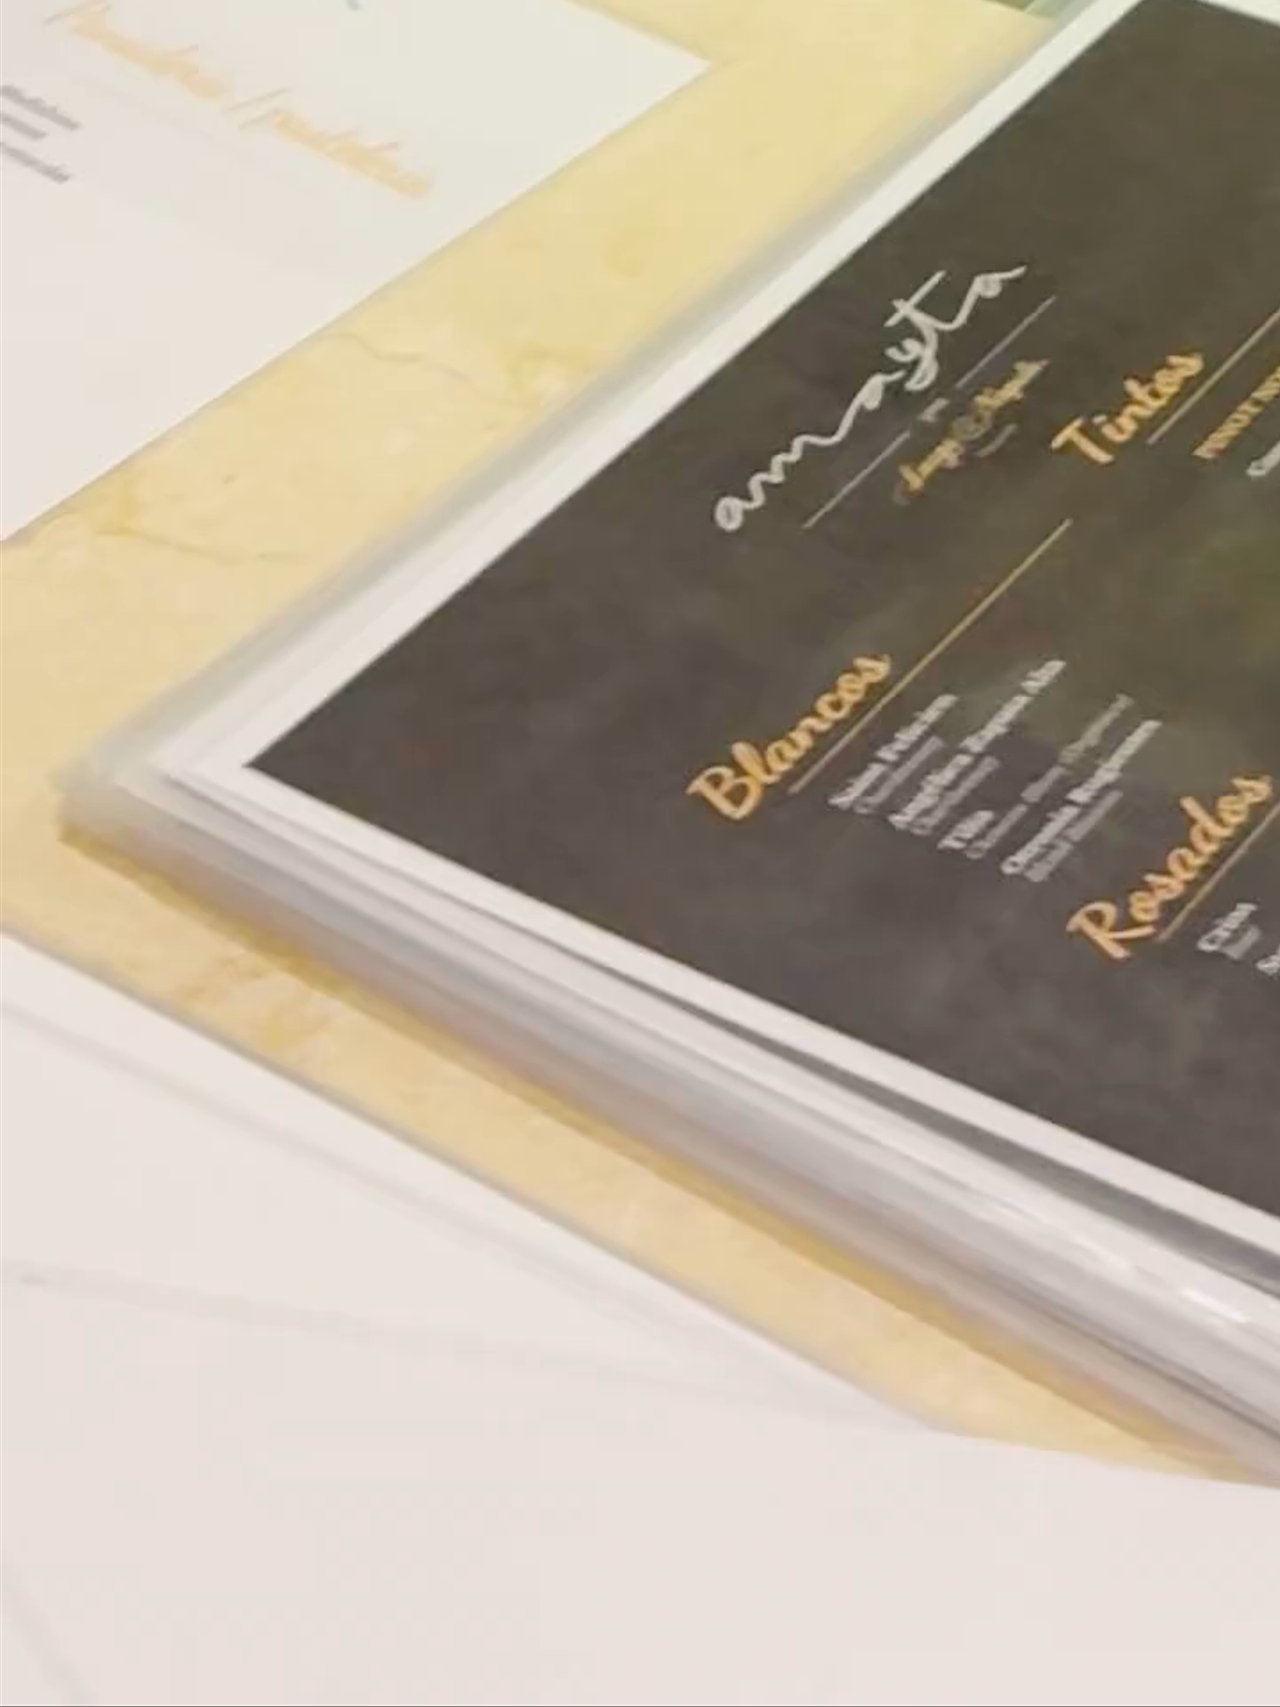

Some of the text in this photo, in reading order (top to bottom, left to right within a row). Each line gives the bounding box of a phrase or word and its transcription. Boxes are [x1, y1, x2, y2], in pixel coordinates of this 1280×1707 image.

[715, 267, 1024, 530] amayta
[1051, 354, 1203, 463] Tintos
[687, 656, 890, 819] Blancos
[1067, 776, 1272, 958] Rosados
